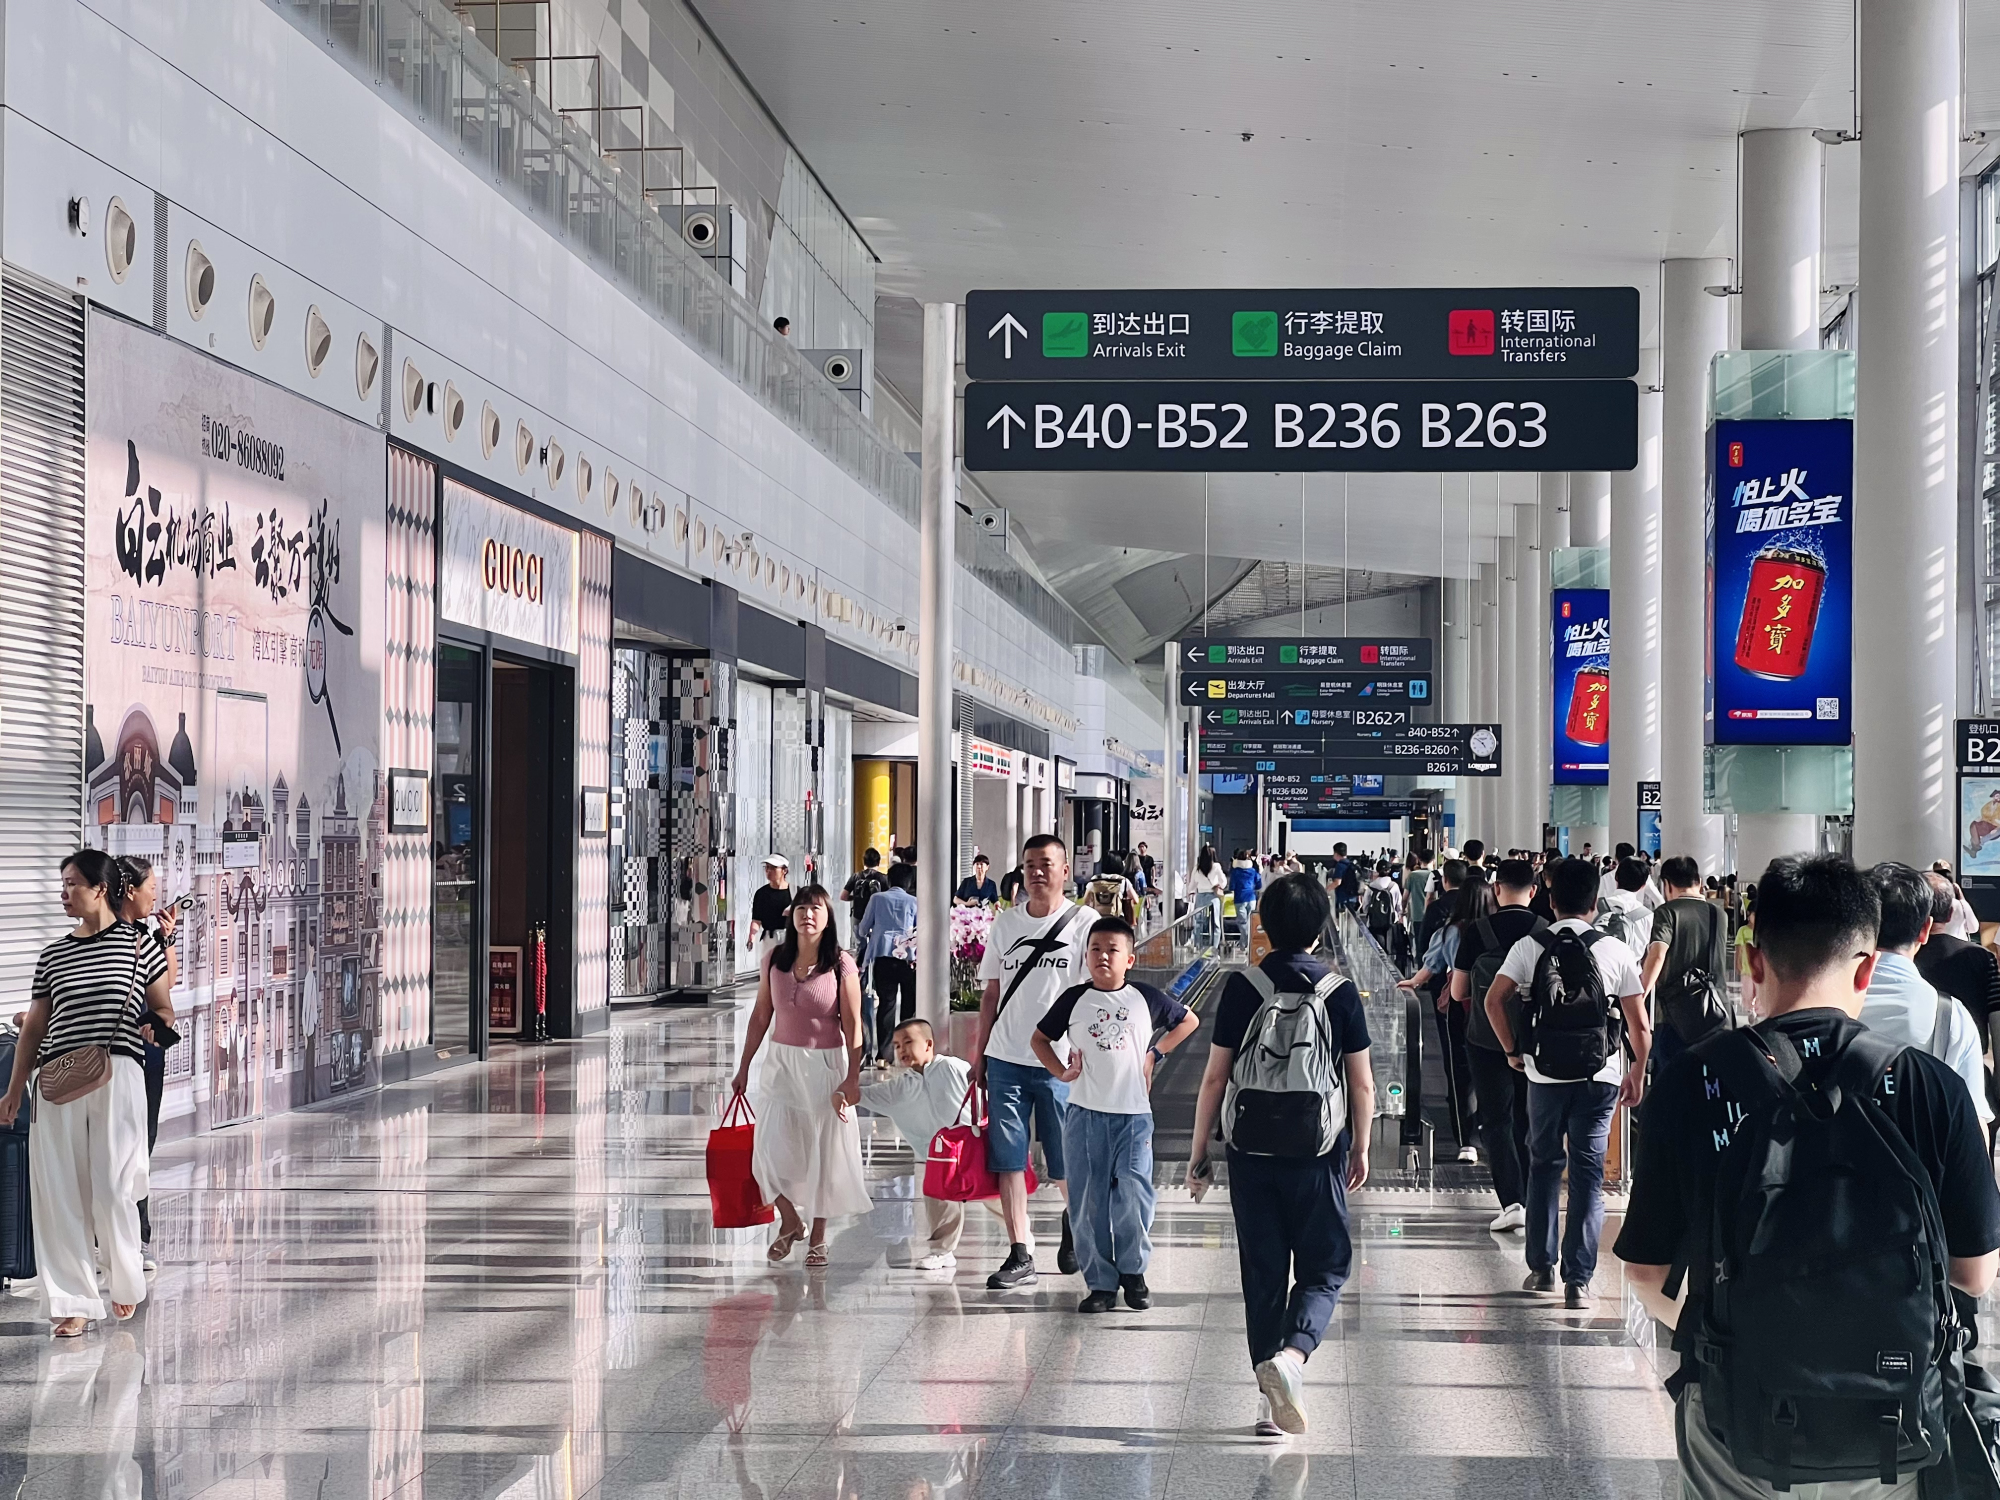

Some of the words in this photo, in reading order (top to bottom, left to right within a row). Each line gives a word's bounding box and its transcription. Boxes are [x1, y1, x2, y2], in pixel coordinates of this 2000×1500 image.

[1092, 311, 1190, 336] 到达出口
[1284, 311, 1384, 335] 行李提取
[1500, 309, 1576, 333] 转国际
[1501, 334, 1596, 348] International
[1093, 342, 1153, 358] Arrivals
[1157, 342, 1186, 358] Exit
[1284, 342, 1354, 361] Baggage
[1357, 342, 1402, 357] Claim
[1502, 349, 1567, 363] Transfers
[1034, 403, 1249, 449] B40-B52
[1274, 403, 1401, 449] B236
[1422, 402, 1548, 449] B263
[211, 420, 285, 482] 020-86088092
[1731, 467, 1810, 509] 怕上火
[115, 438, 237, 589] 白云机场商业
[1735, 495, 1843, 534] 喝加多宝
[482, 537, 544, 606] GUCCI
[110, 594, 237, 661] BAIYUNPORT
[1563, 617, 1610, 643] 怕上火
[1227, 645, 1265, 656] 到达出口
[1299, 645, 1338, 656] 行李提取
[1380, 645, 1409, 656] 转国际
[1299, 657, 1326, 665] Baggage
[1227, 680, 1265, 691] 出发大厅
[1238, 709, 1270, 718] 到达出口
[1311, 710, 1351, 719] 母婴休息室
[1356, 711, 1393, 725] B262
[1311, 718, 1335, 726] Nursery
[1968, 723, 1999, 734] 登机口
[1394, 744, 1450, 755] B236-B260
[1967, 737, 2000, 763] B2
[1426, 762, 1450, 772] B261
[1272, 775, 1301, 783] B40-B52
[1272, 787, 1308, 795] B236-B260
[1642, 790, 1661, 805] B2
[1802, 1037, 1821, 1058] M
[1883, 1074, 1895, 1094] E
